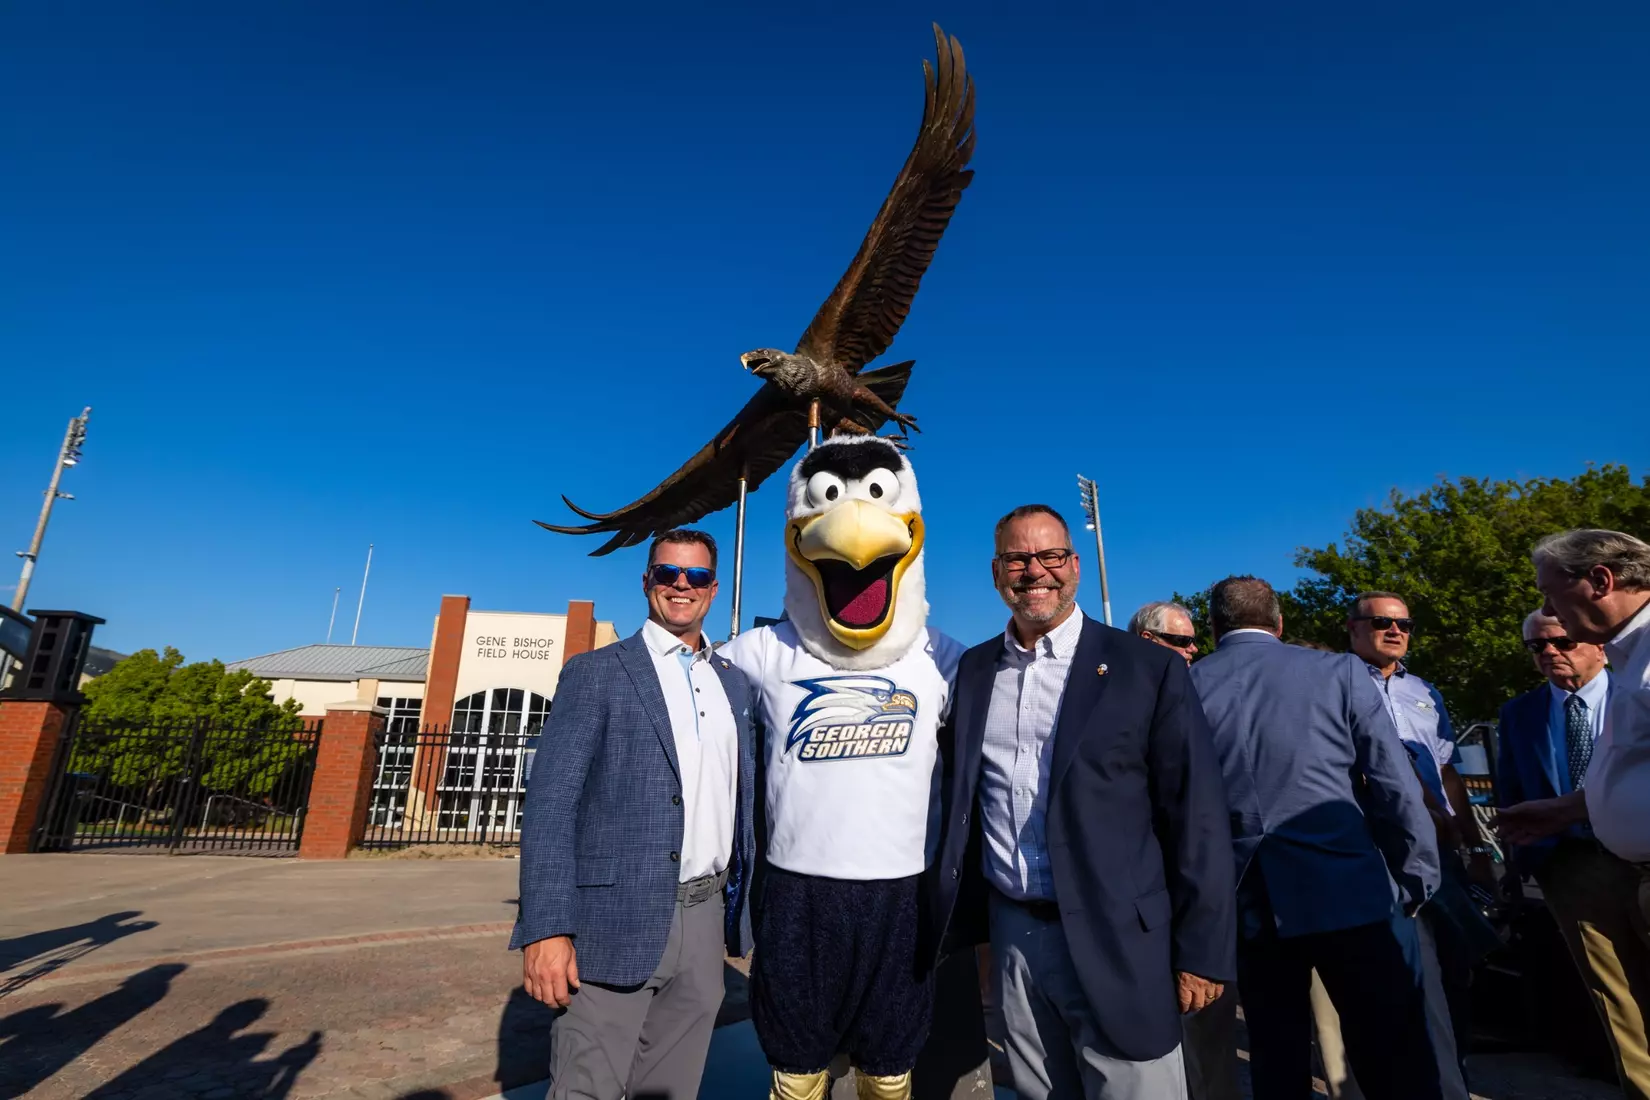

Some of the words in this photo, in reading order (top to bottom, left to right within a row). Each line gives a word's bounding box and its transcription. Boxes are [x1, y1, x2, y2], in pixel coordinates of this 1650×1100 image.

[476, 636, 507, 647] GENE
[513, 637, 554, 649] BISHOP
[477, 648, 507, 658] FIELD
[512, 650, 550, 660] HOUSE
[809, 722, 910, 742] GEORGIA
[801, 738, 907, 758] SOUTHERN
